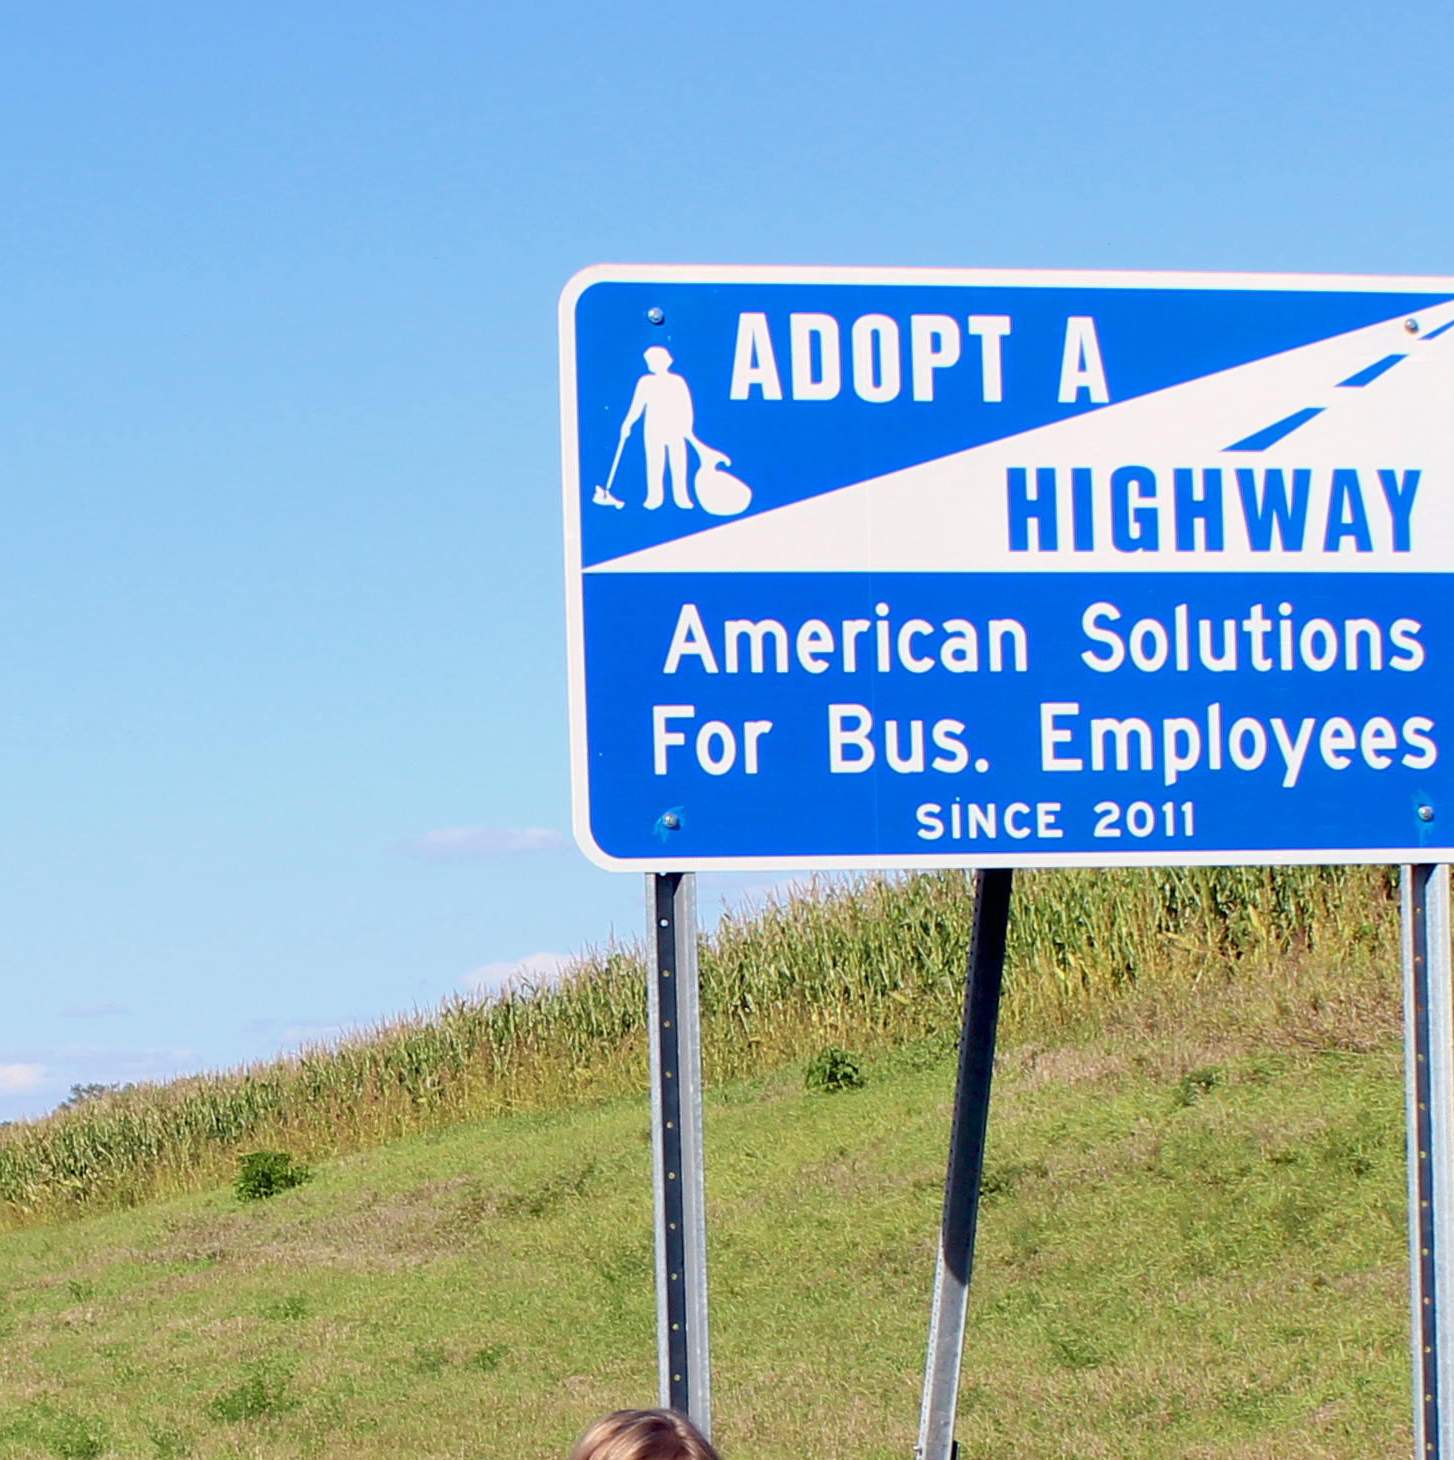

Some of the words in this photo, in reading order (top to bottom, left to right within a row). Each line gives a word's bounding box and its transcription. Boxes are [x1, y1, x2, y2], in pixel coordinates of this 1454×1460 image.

[730, 311, 1012, 403] ADOPT
[1058, 315, 1110, 403] A
[1007, 465, 1421, 553] HIGHWAY
[663, 602, 1028, 674] American
[1081, 601, 1426, 673] Solutions
[652, 704, 773, 776] For
[828, 703, 990, 774] Bus.
[1040, 701, 1438, 788] Employees
[916, 801, 1064, 840] SINCE
[1094, 800, 1194, 838] 2011
